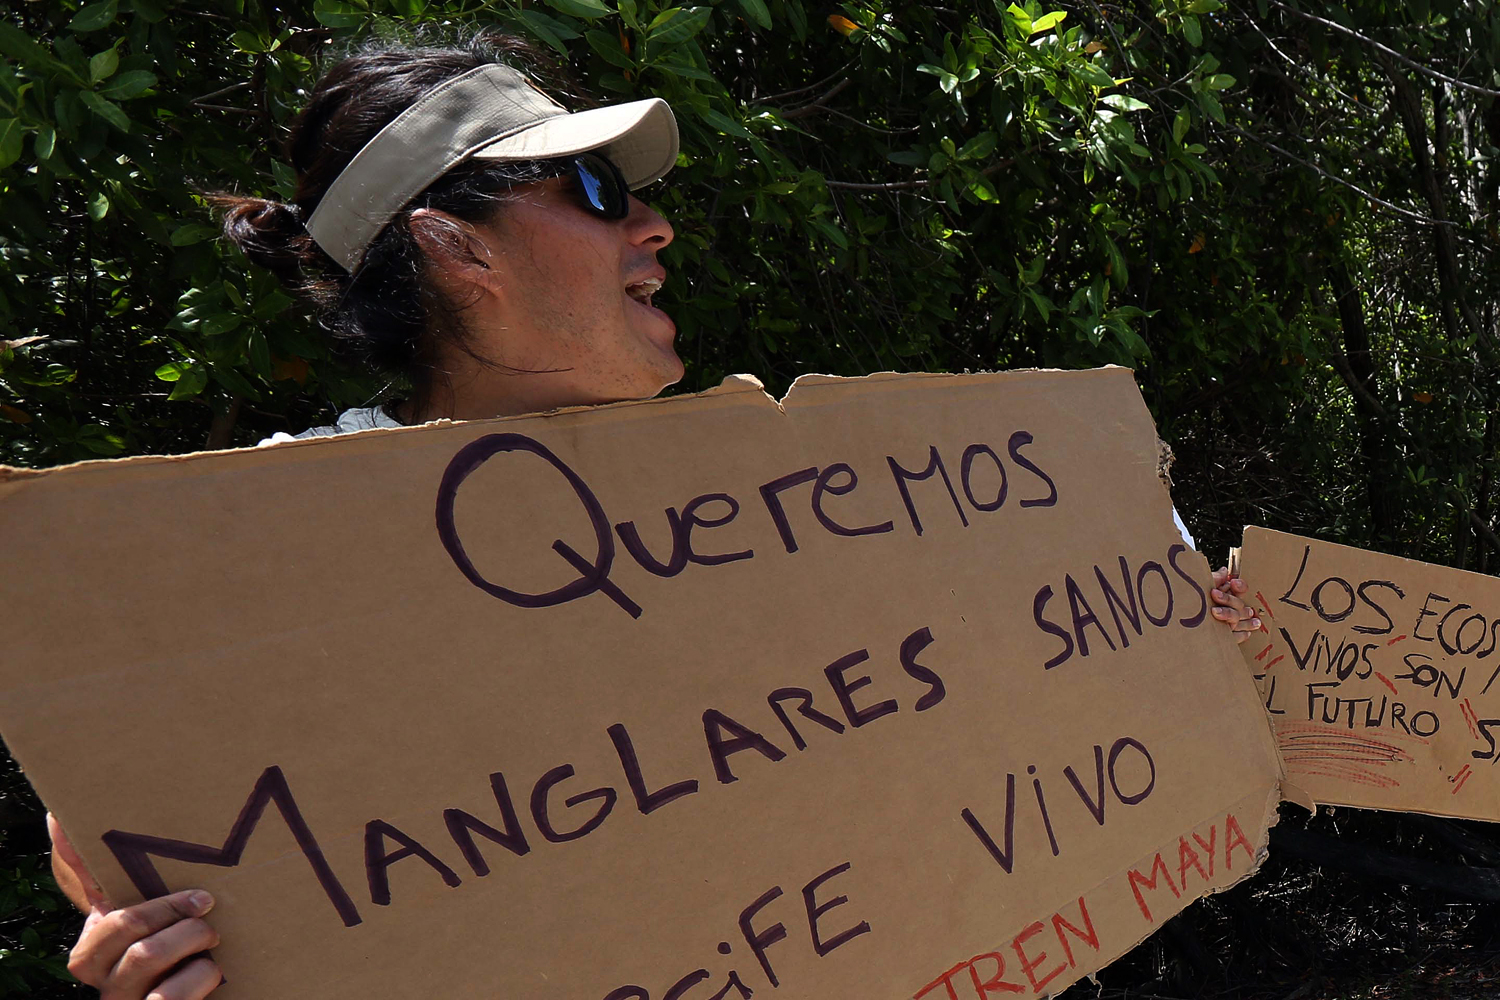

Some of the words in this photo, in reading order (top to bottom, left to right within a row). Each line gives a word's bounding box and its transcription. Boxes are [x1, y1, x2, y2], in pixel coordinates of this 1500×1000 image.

[1279, 545, 1406, 635] LOS
[1305, 682, 1440, 737] FUTURO
[1394, 653, 1467, 699] SON
[102, 626, 945, 984] MANGLARES
[1033, 544, 1206, 670] SANOS
[1126, 814, 1256, 923] MAYA
